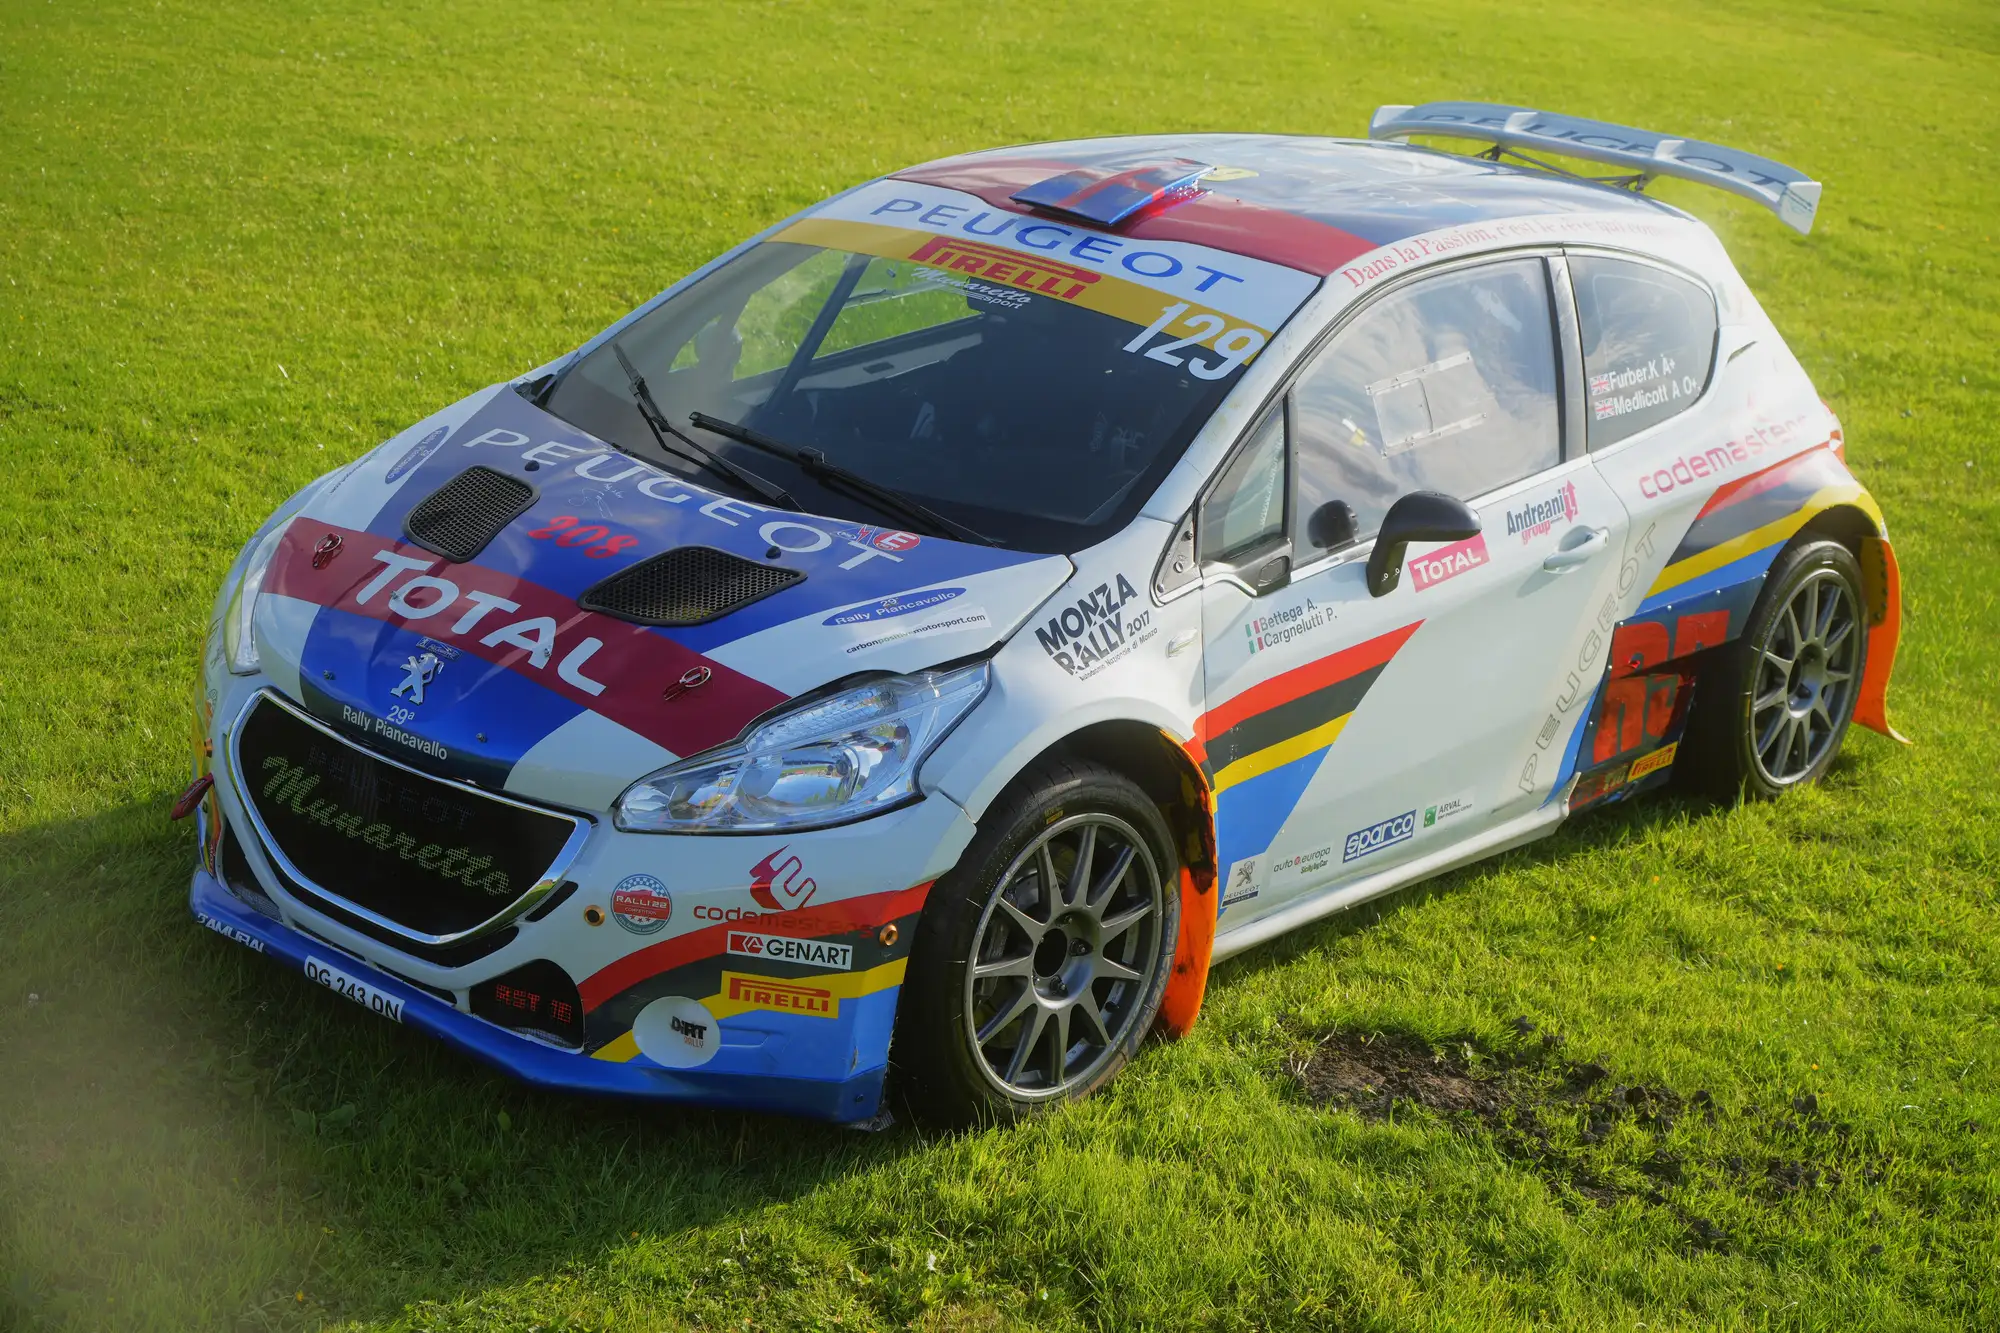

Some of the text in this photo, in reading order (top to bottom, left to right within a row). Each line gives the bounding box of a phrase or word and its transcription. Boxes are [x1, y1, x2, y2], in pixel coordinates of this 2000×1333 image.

[869, 198, 1244, 292] PEUGEOT
[1341, 254, 1398, 289] Dans
[1399, 244, 1421, 264] la
[1418, 224, 1498, 257] Passion,
[908, 236, 1103, 300] PIRELLI
[911, 266, 1032, 304] Munaretto
[1123, 301, 1266, 381] 129
[1613, 385, 1669, 416] Medlicott
[1673, 380, 1682, 398] A
[463, 427, 903, 571] PEUGEOT
[1507, 488, 1565, 536] Andreani
[527, 515, 639, 560] 208
[1522, 520, 1551, 546] group
[1413, 547, 1482, 584] TOTAL
[356, 549, 607, 697] TOTAL
[835, 591, 956, 626] Rally Piancavallo
[1034, 572, 1139, 657] MONZA
[1259, 597, 1318, 632] Bettega A.
[1263, 606, 1338, 648] Cargnelutti P.
[1052, 609, 1151, 676] RALLY 2017
[1138, 627, 1158, 644] Monza
[1518, 522, 1656, 794] PEUGEOT
[342, 704, 448, 760] Rally Piancavallo
[1632, 747, 1674, 777] PIRELLI
[262, 755, 512, 896] Munaretto
[1438, 799, 1461, 814] ARVAL
[1345, 813, 1414, 857] sparco
[1273, 847, 1331, 873] auto europa
[1224, 884, 1260, 900] PEUGEOT
[197, 913, 265, 953] SAMURAI
[694, 904, 876, 939] codemasters
[766, 938, 850, 966] GENART
[336, 976, 367, 1006] 243
[372, 993, 399, 1022] DN
[729, 977, 830, 1012] PIRELLI
